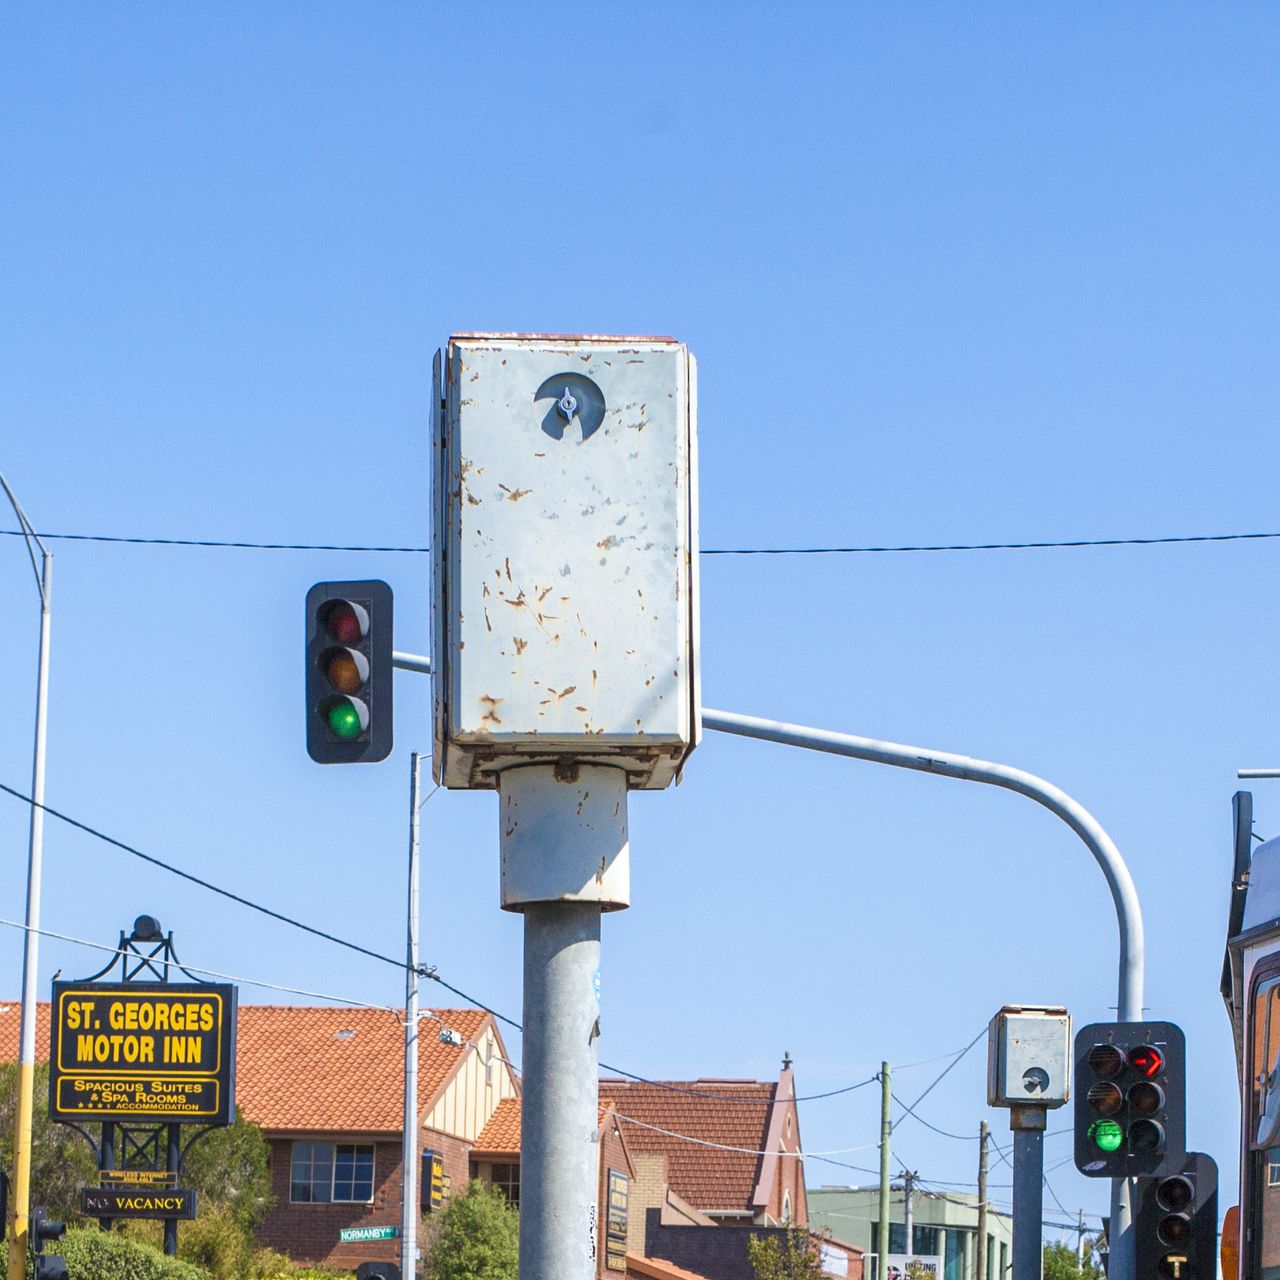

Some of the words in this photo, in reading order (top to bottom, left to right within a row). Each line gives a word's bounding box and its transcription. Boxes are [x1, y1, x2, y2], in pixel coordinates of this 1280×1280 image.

[67, 1001, 101, 1030] ST.
[109, 1002, 214, 1031] GEORGES
[77, 1034, 155, 1063] MOTOR
[163, 1036, 202, 1063] INN
[116, 1103, 199, 1111] ACCOMMODATION
[115, 1197, 184, 1209] VACANCY
[341, 1228, 386, 1240] NORMANBY
